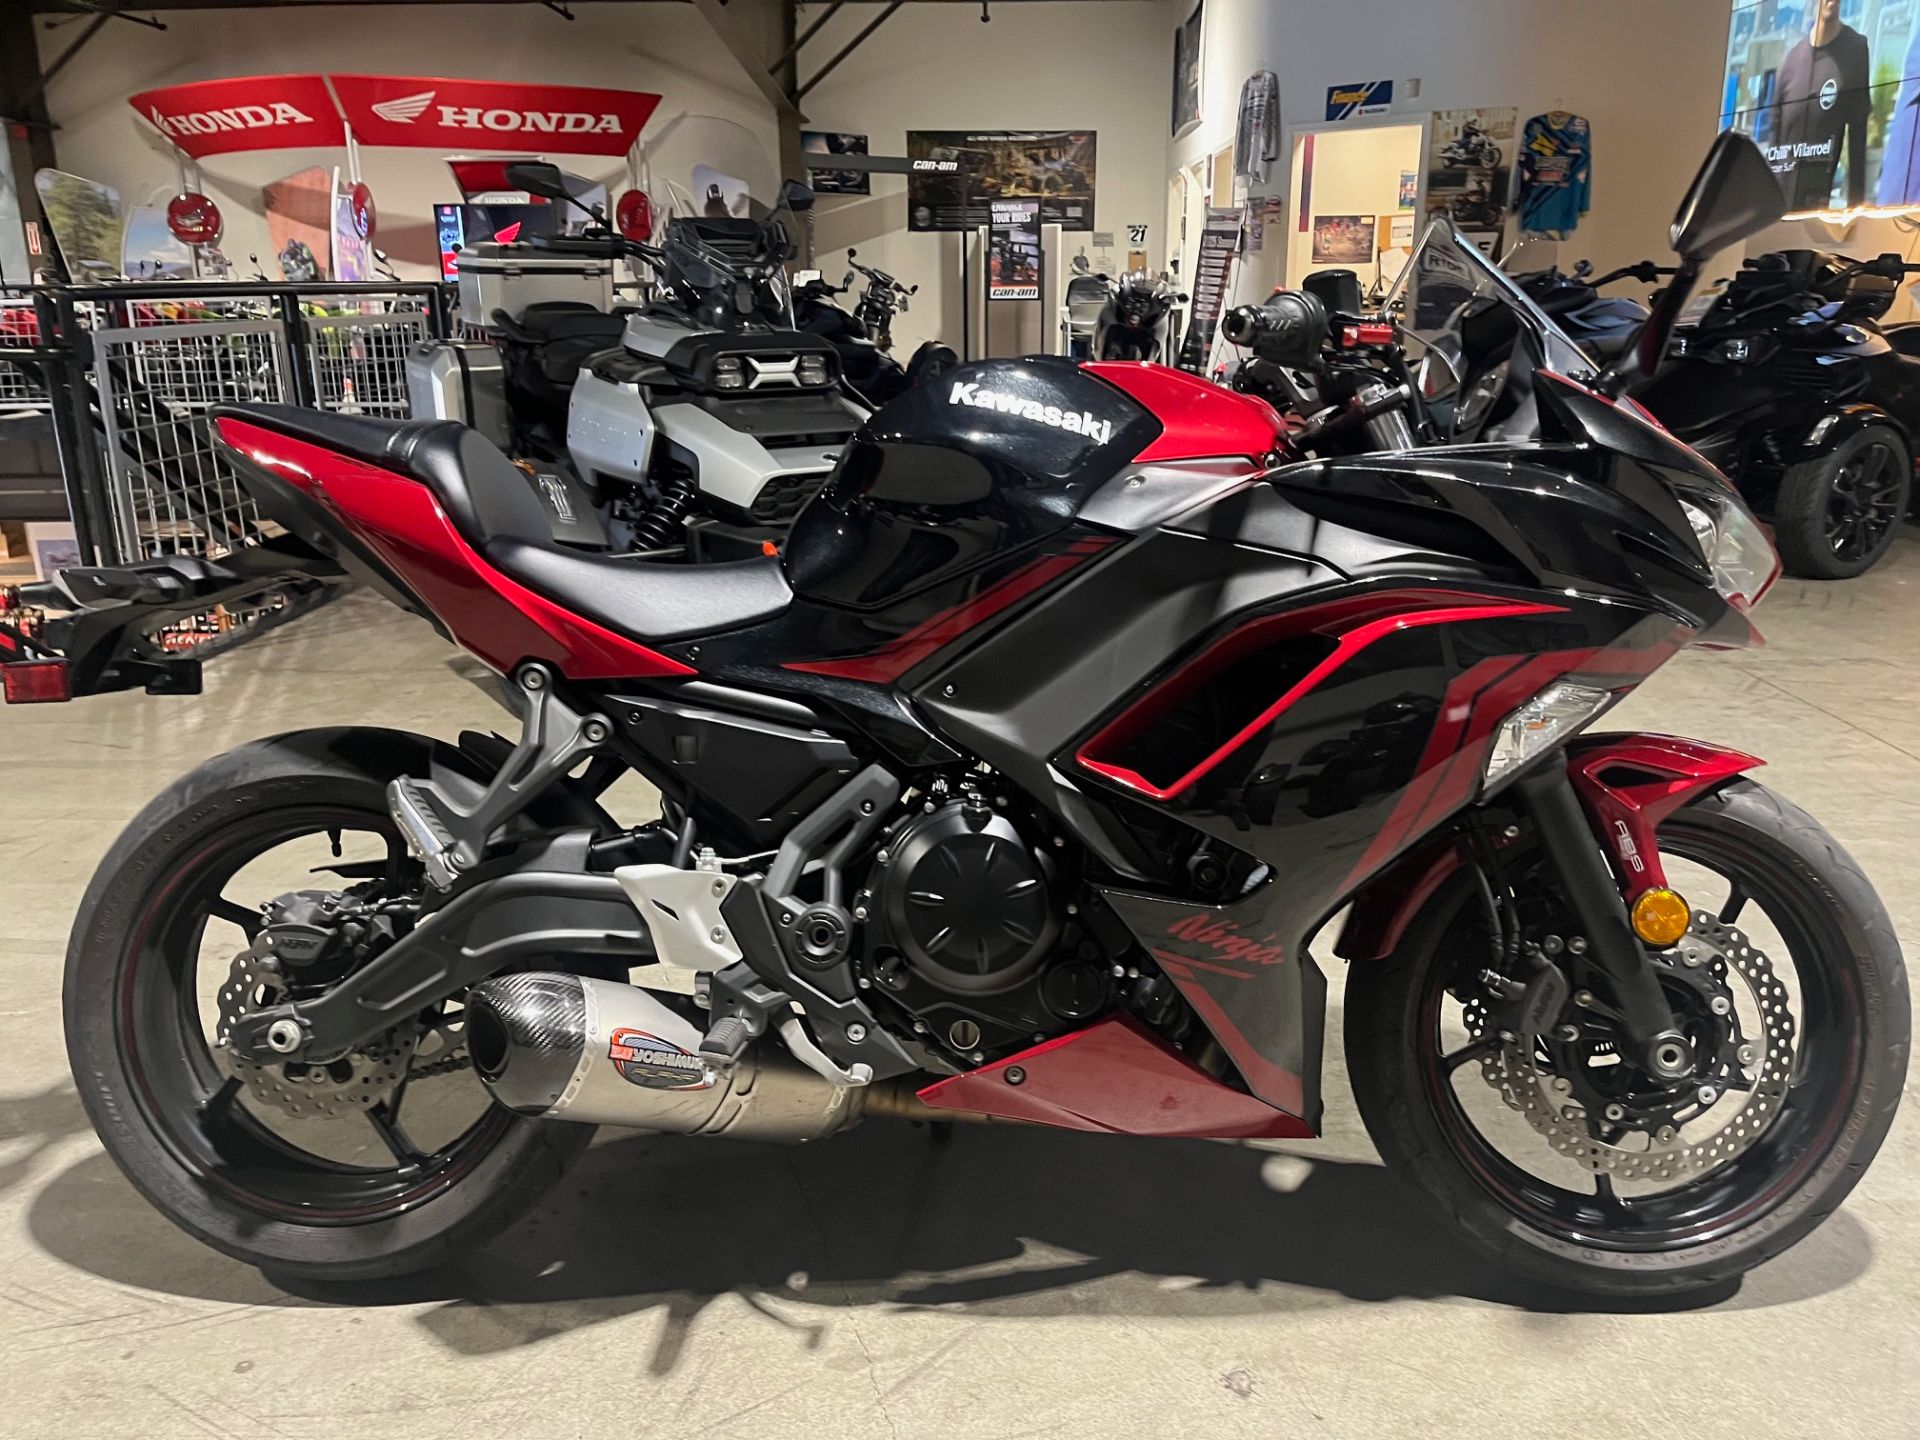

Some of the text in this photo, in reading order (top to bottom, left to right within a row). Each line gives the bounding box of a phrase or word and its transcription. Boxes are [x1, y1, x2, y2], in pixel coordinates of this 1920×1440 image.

[165, 102, 314, 136] HONDA
[437, 105, 624, 133] HONDA
[1793, 139, 1831, 158] Villarroel
[992, 213, 1010, 223] YOUR
[1130, 228, 1146, 242] 21
[992, 288, 1037, 297] can-am
[949, 382, 1112, 446] Kawasaki
[1614, 820, 1645, 873] ABS
[1167, 912, 1285, 965] Ninja
